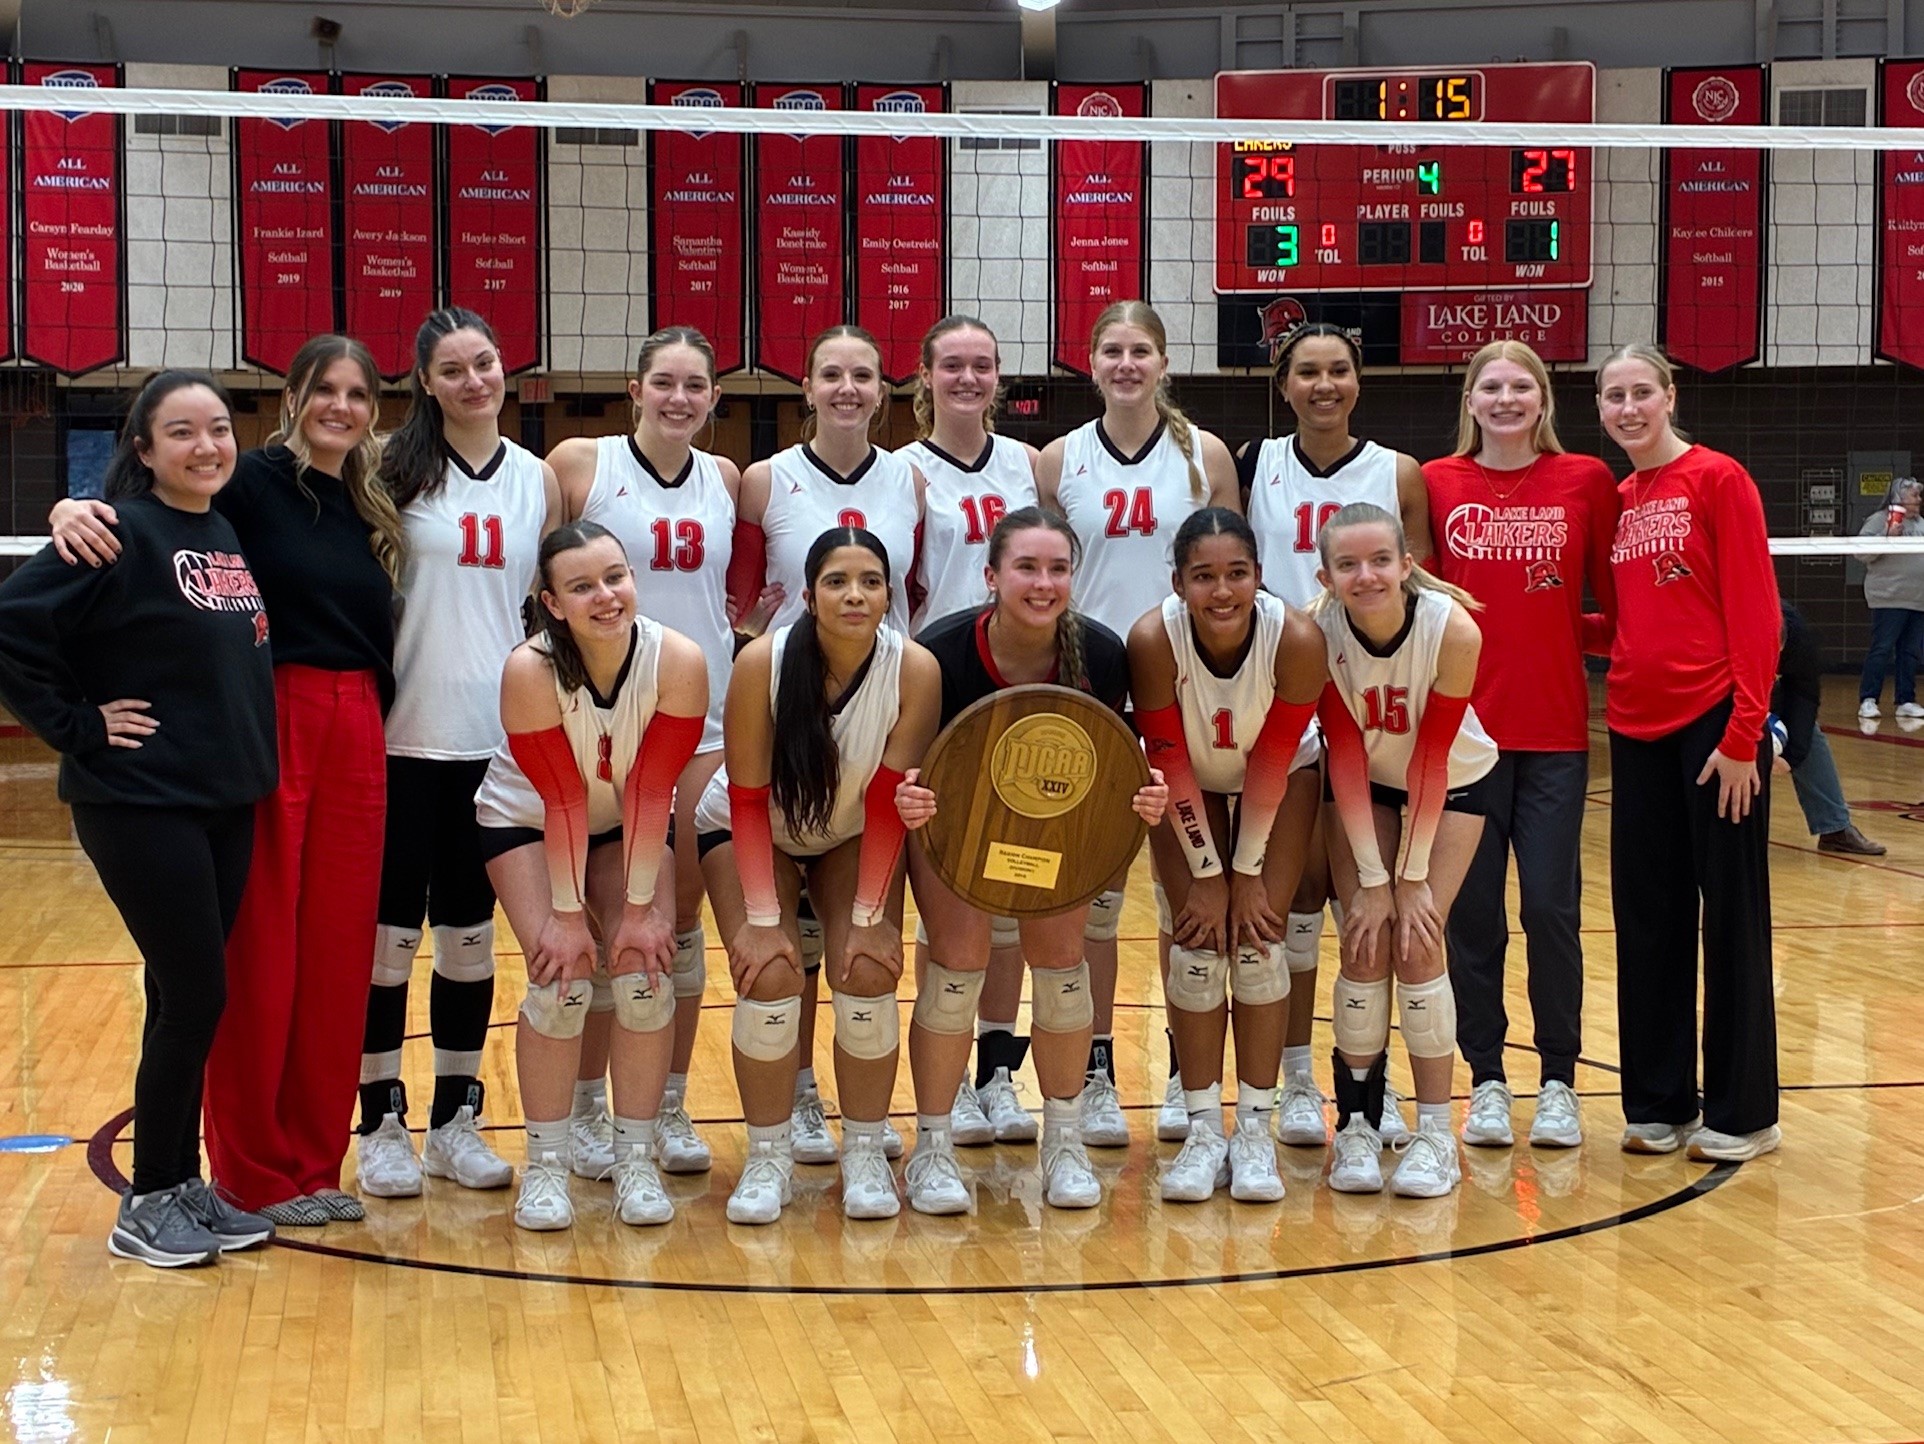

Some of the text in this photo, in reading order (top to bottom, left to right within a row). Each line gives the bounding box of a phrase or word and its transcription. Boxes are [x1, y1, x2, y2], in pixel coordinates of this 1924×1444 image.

[57, 158, 87, 170] ALL
[273, 163, 302, 174] ALL
[1698, 161, 1726, 172] ALL
[376, 166, 404, 177] ALL
[480, 170, 509, 182] ALL
[1363, 168, 1415, 184] PERIOD
[1522, 149, 1575, 192] 27
[34, 174, 110, 189] AMERICAN
[685, 173, 713, 184] ALL
[788, 176, 815, 187] ALL
[888, 176, 914, 187] ALL
[1085, 174, 1112, 184] ALL
[1244, 156, 1294, 198] 29
[1418, 161, 1439, 195] 4
[250, 181, 324, 193] AMERICAN
[353, 184, 427, 196] AMERICAN
[1678, 180, 1750, 192] AMERICAN
[459, 188, 531, 200] AMERICAN
[664, 191, 735, 203] AMERICAN
[766, 194, 836, 205] AMERICAN
[866, 193, 935, 205] AMERICAN
[1066, 192, 1133, 203] AMERICAN
[1252, 206, 1296, 221] FOULS
[1357, 202, 1465, 219] PLAYER FOULS
[1511, 201, 1556, 216] FOULS
[253, 226, 324, 238] Frankie Izard
[353, 229, 383, 242] Avery
[498, 232, 526, 245] Short
[862, 237, 891, 250] Emily
[1070, 236, 1129, 247] Jenna Jones
[1275, 225, 1299, 266] 3
[268, 252, 308, 263] Softball
[1315, 249, 1342, 264] TOL
[1461, 246, 1488, 261] TOL
[1692, 252, 1732, 263] Softball
[366, 255, 412, 267] Women's
[678, 260, 717, 271] Softball
[1081, 260, 1118, 272] Softball
[881, 263, 919, 274] Softball
[1515, 264, 1545, 278] WON
[277, 273, 300, 284] 2019
[1257, 269, 1286, 283] WON
[1701, 276, 1724, 287] 2015
[690, 280, 712, 291] 2017
[1473, 294, 1515, 302] GIFTED BY
[888, 300, 910, 310] 2017
[1427, 303, 1562, 330] LAKE LAND
[1441, 329, 1547, 344] COLLEGE
[1657, 496, 1690, 512] LAND
[1103, 487, 1158, 538] 24
[1494, 506, 1565, 520] LAKE LAND
[959, 493, 1007, 545] 16
[1465, 521, 1568, 547] LAKERS
[458, 512, 505, 570] 11
[651, 517, 705, 572] 13
[1362, 686, 1412, 735] 15
[1212, 708, 1238, 750] 1
[1041, 779, 1070, 794] XXIV
[1175, 798, 1206, 849] LAKE LAND
